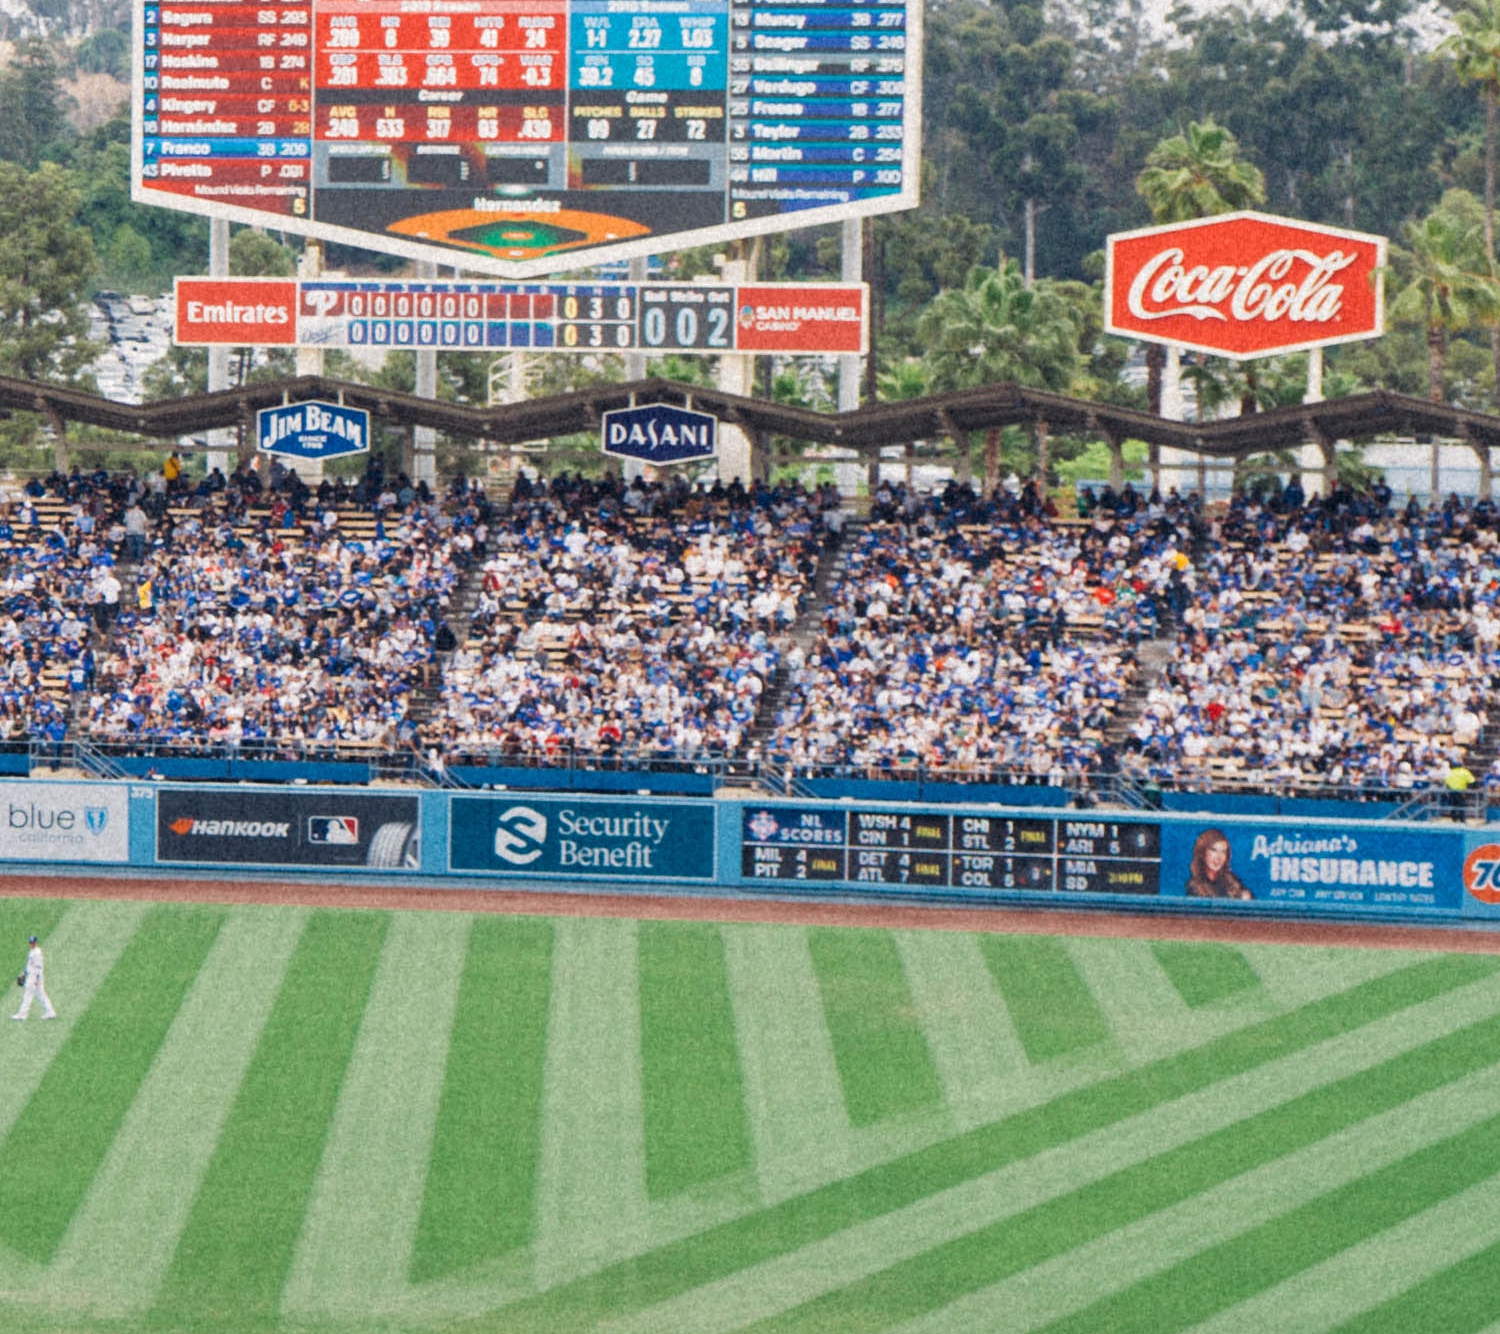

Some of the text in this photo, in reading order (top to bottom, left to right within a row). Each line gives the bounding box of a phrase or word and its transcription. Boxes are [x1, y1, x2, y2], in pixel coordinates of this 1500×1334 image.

[1128, 248, 1358, 322] Coca-Cola
[187, 301, 289, 325] Emirates
[756, 306, 860, 322] SAN MANUEL
[263, 405, 363, 448] JIM BEAM
[610, 417, 708, 452] DASANI
[9, 804, 75, 830] blue
[559, 809, 669, 842] Security
[779, 828, 842, 843] SCORES
[1251, 833, 1357, 860] Adriana's
[560, 840, 652, 868] Benefit
[1270, 857, 1434, 888] INSURANCE
